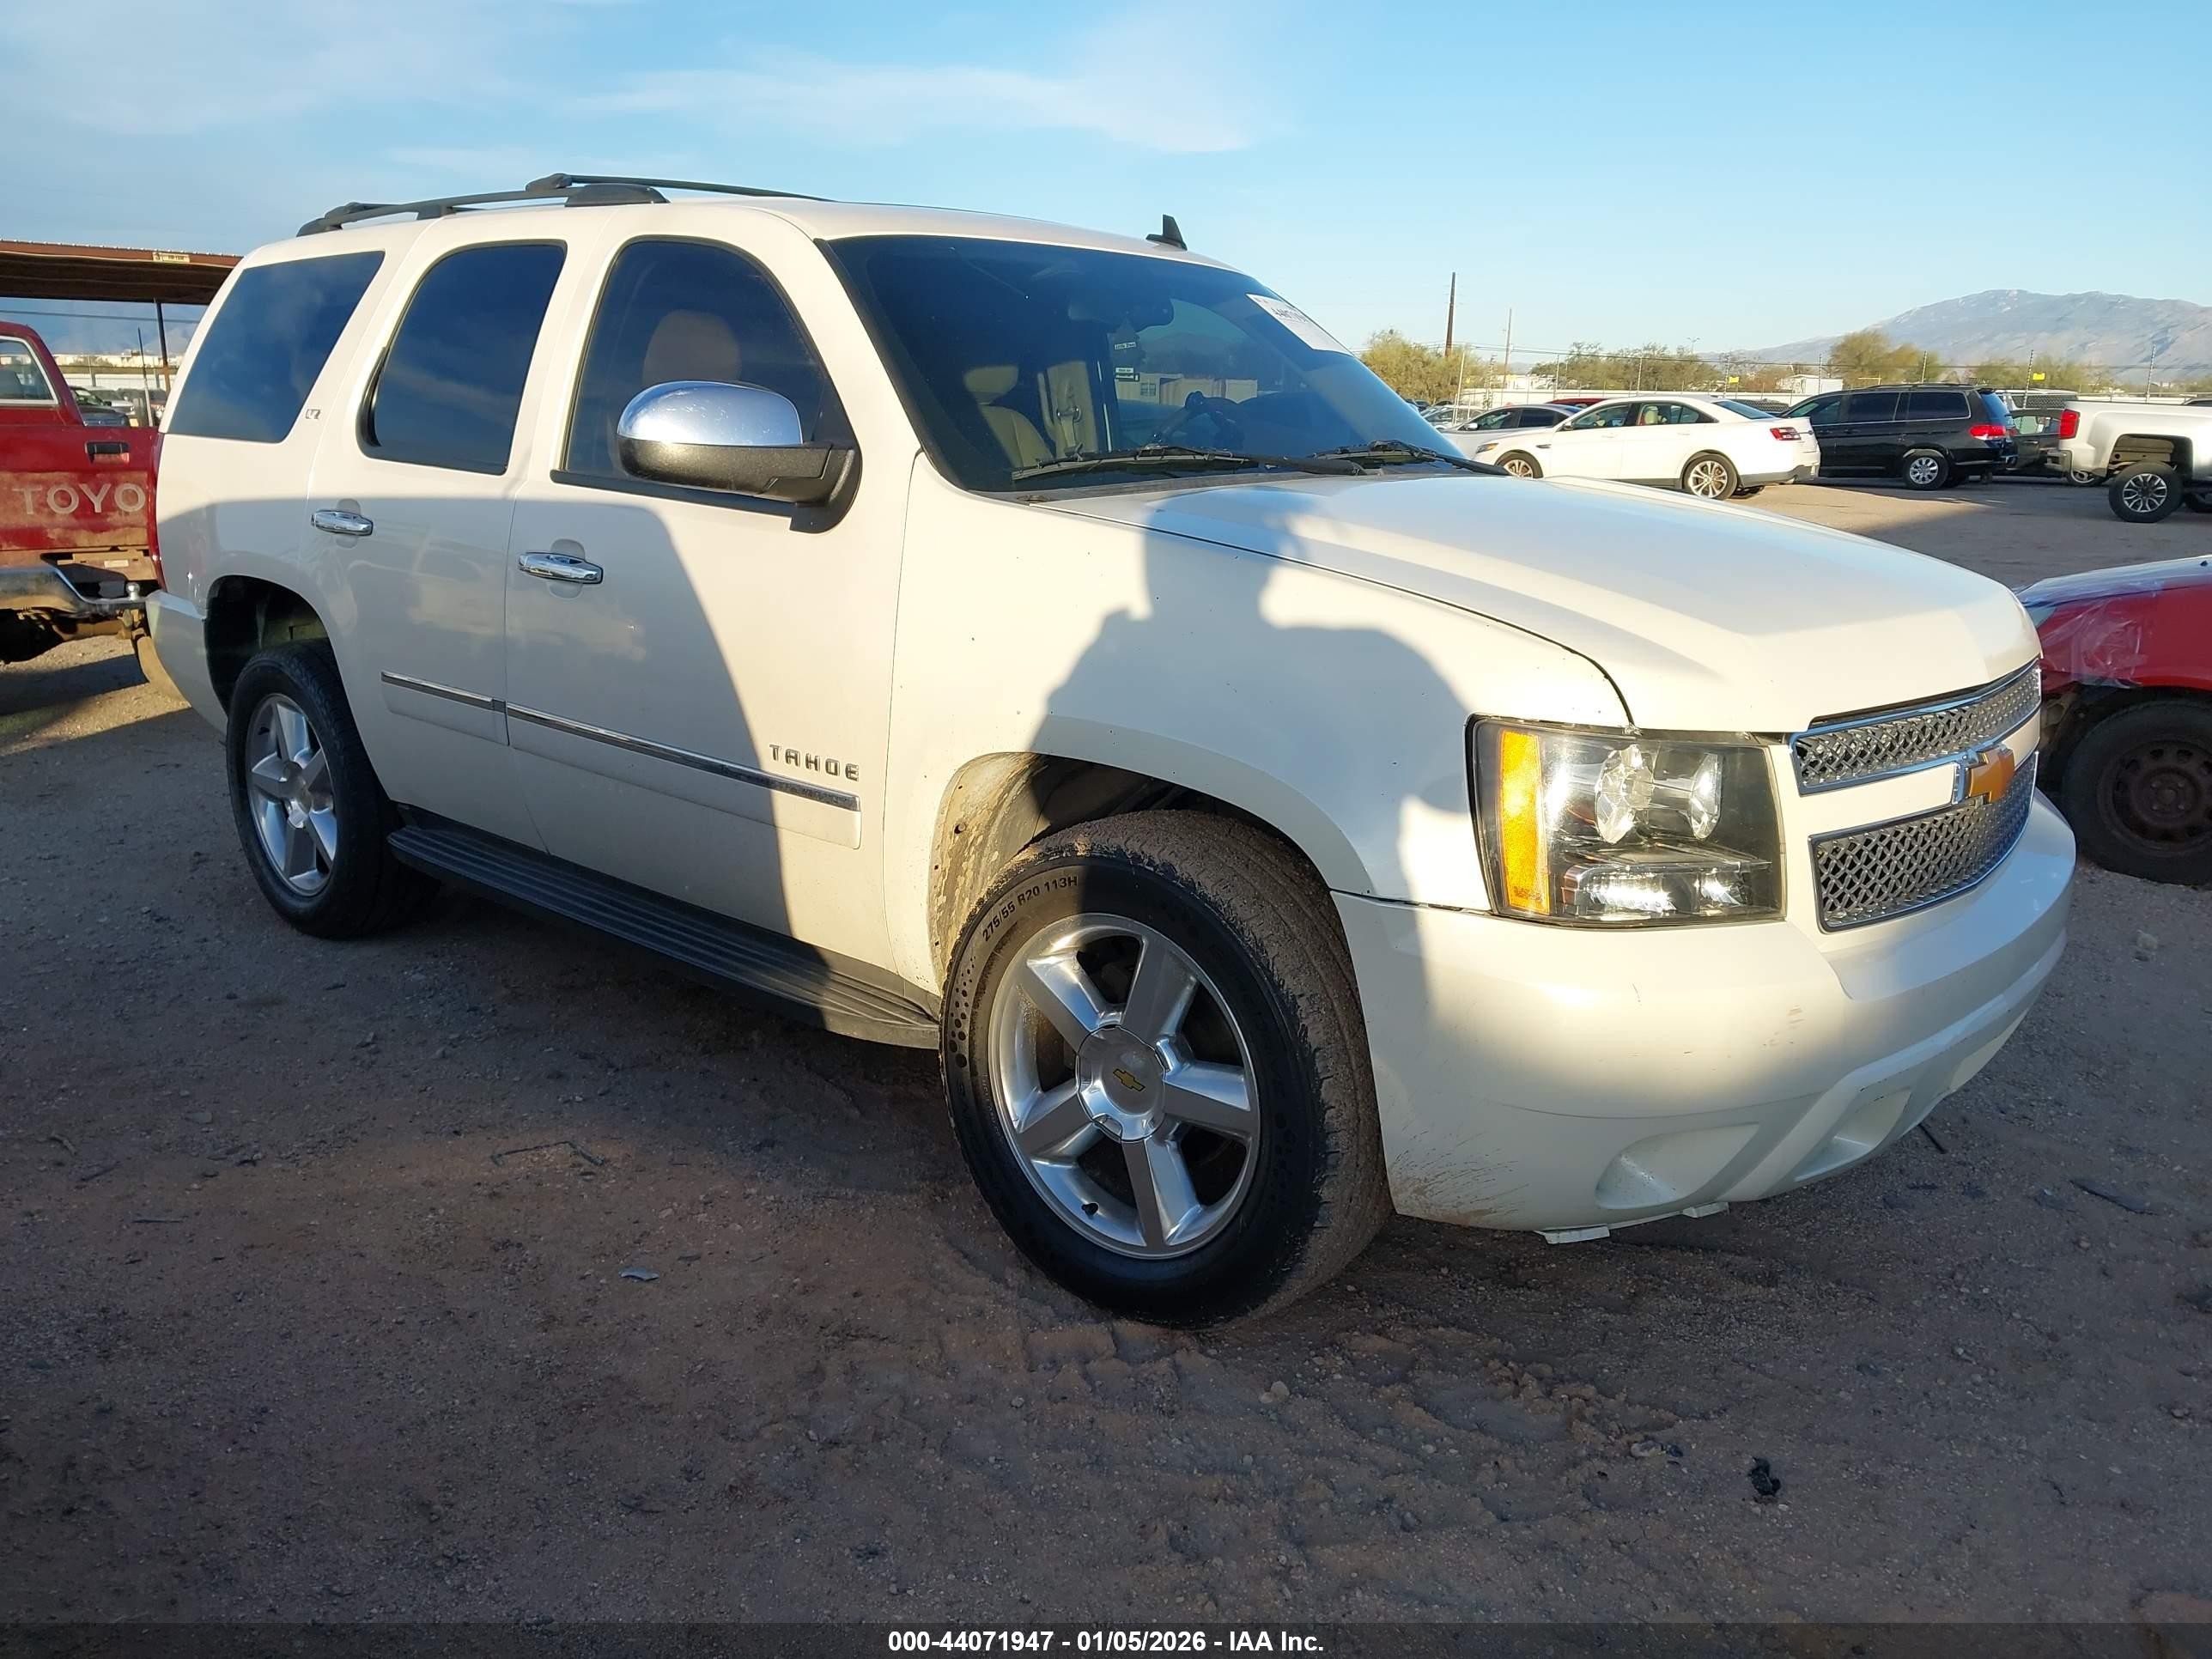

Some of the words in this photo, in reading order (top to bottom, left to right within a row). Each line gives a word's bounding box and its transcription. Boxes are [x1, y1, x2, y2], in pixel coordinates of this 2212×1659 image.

[12, 483, 146, 514] TOYO
[769, 744, 860, 782] TAHOE
[982, 900, 1016, 942] 275/55
[1017, 885, 1041, 906] R20
[1044, 876, 1078, 892] 113H
